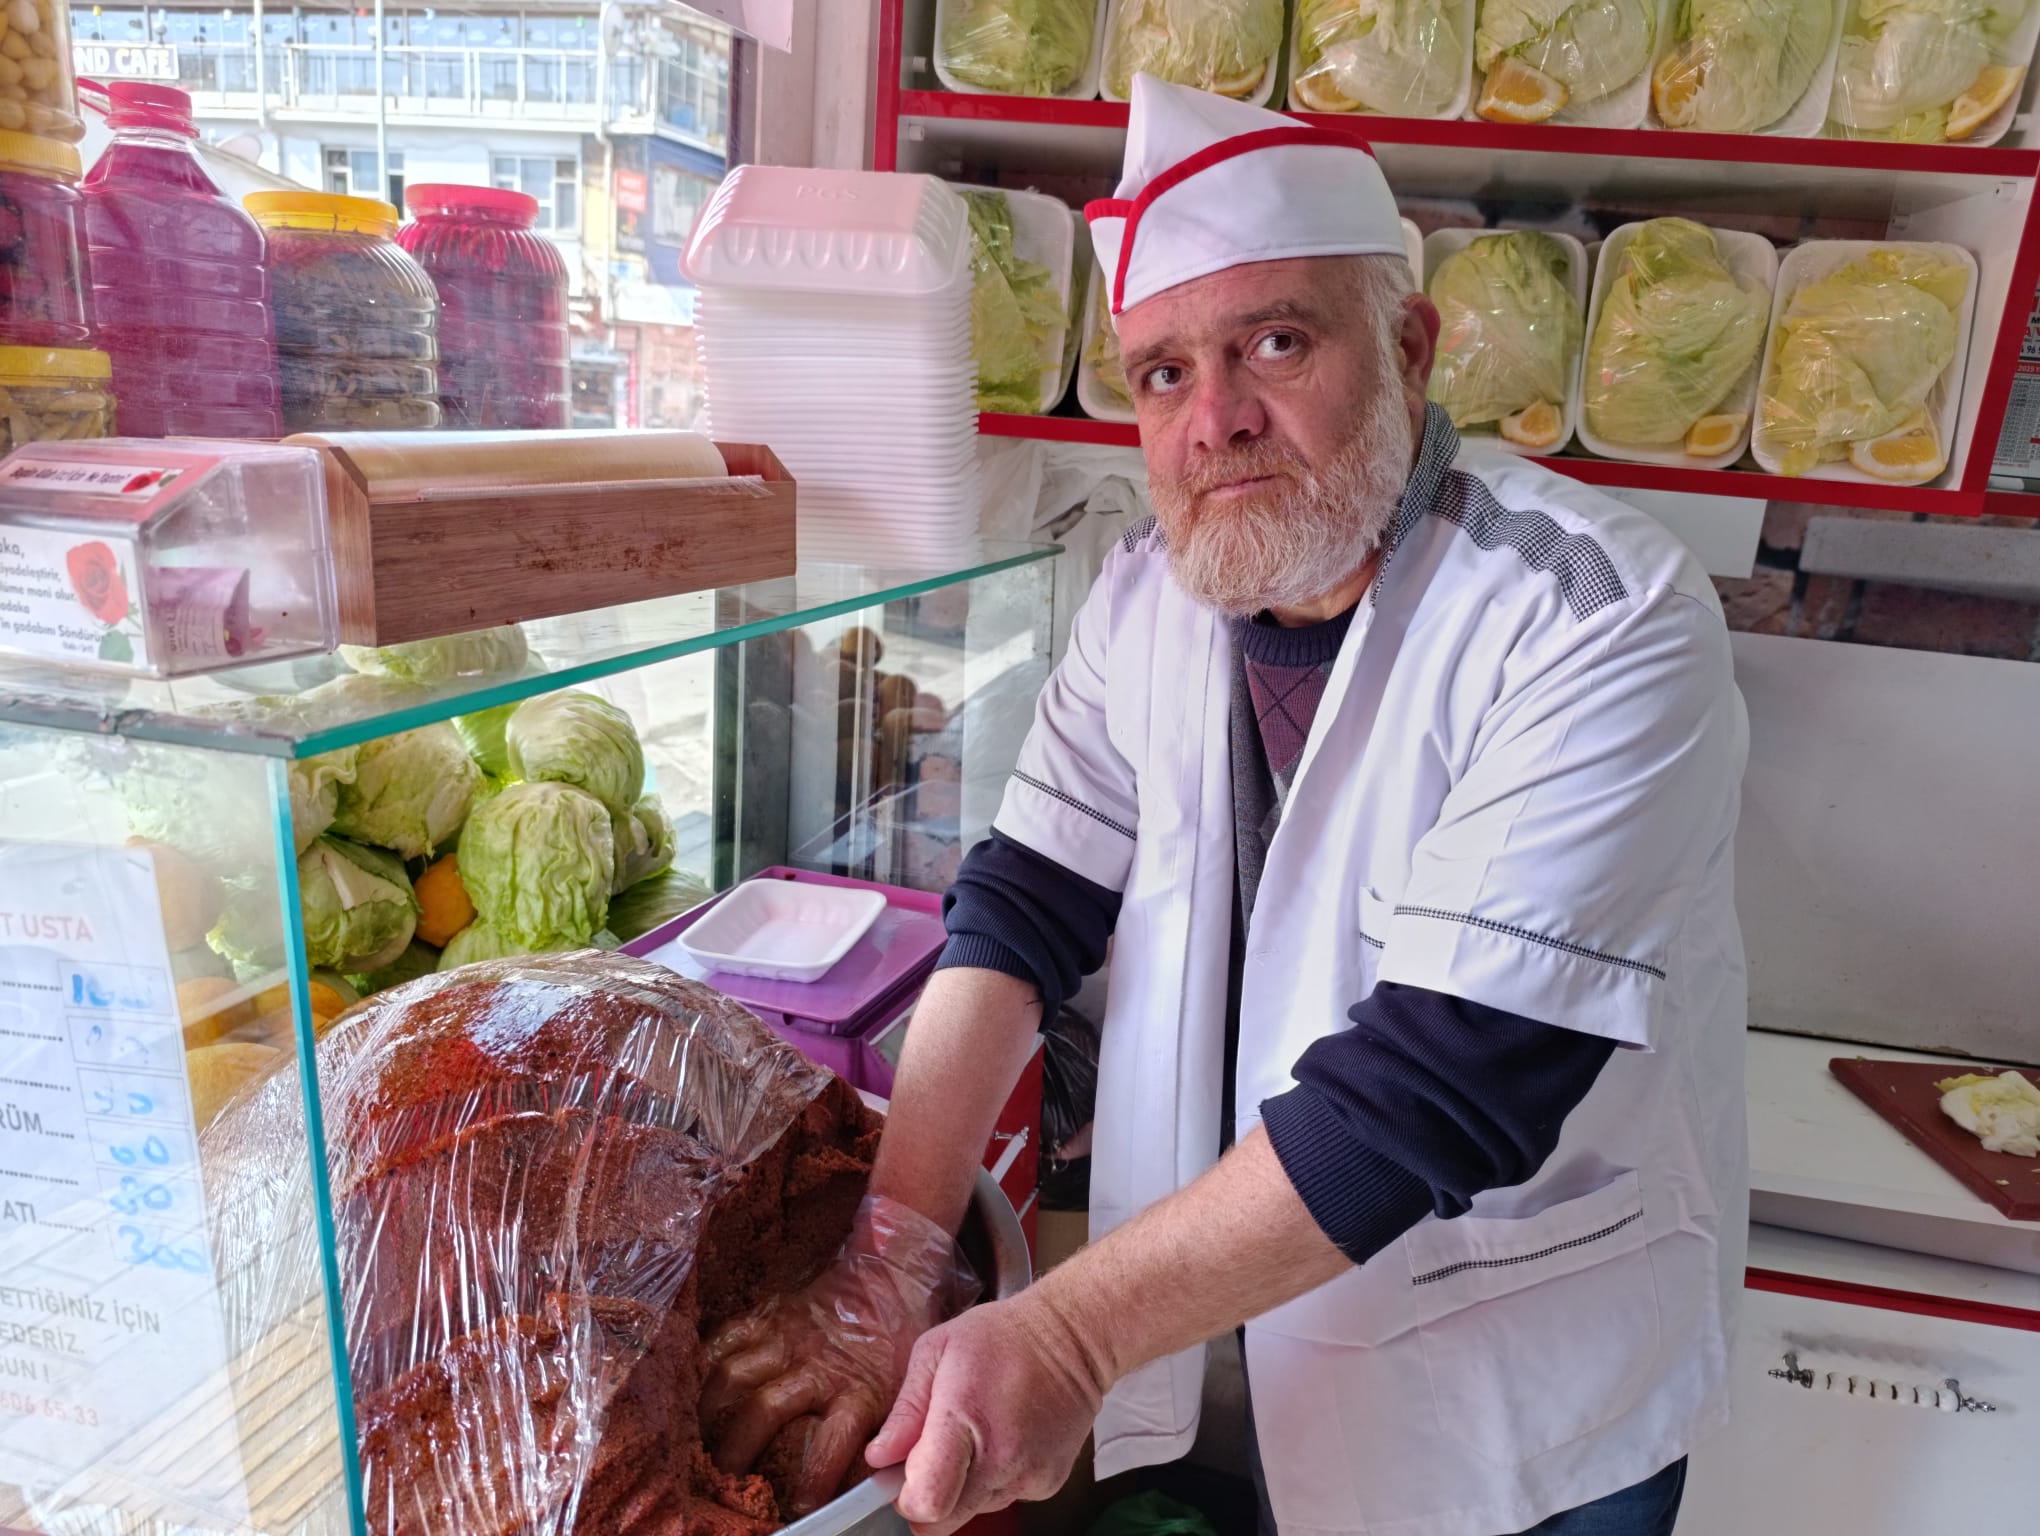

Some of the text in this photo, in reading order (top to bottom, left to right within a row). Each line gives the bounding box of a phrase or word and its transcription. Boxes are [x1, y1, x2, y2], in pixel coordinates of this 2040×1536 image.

[115, 48, 171, 75] CAFE
[22, 914, 94, 943] USTA
[113, 1299, 161, 1334] İÇİN
